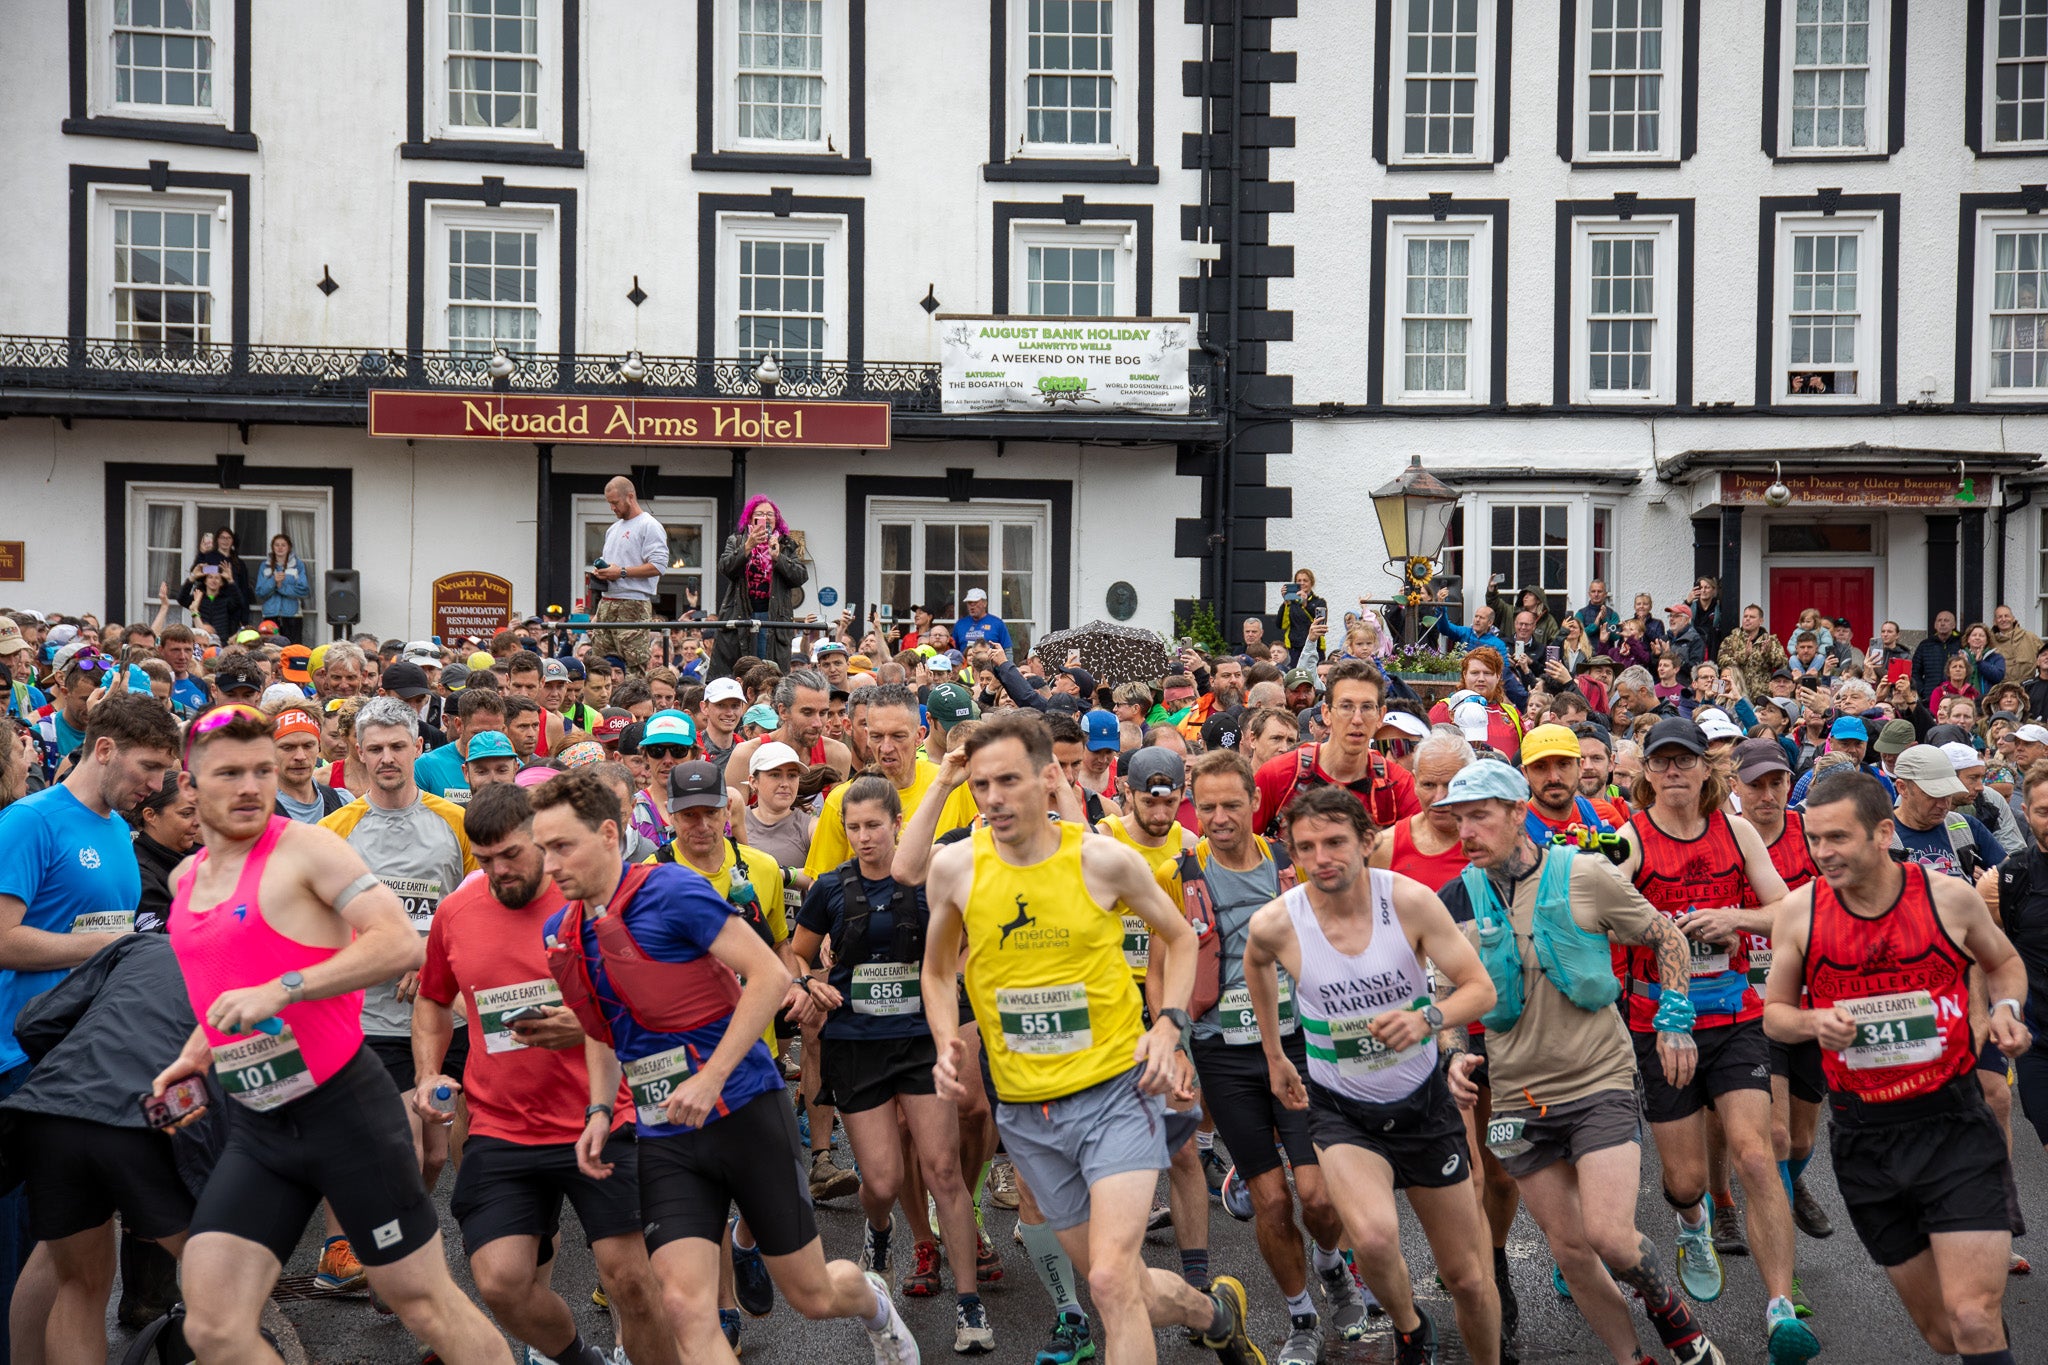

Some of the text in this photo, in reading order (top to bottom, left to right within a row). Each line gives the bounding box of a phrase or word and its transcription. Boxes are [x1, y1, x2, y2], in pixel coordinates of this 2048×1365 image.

[980, 327, 1151, 341] AUGUST BANK HOLIDAY
[1019, 341, 1112, 351] LLANWRTYD WELLS
[991, 354, 1141, 365] A WEEKEND ON THE BOG
[968, 380, 1024, 389] BOGATHLON
[1038, 376, 1088, 392] GREEN
[1130, 383, 1185, 391] BOGSNORKELLING
[605, 405, 698, 436] Arms
[712, 406, 803, 438] Hotel
[1736, 475, 1768, 488] Home
[1787, 479, 1806, 488] the
[1811, 475, 1844, 489] Heart
[1848, 480, 1860, 490] of
[1864, 478, 1900, 489] Wales
[1904, 478, 1952, 491] Brewery
[1803, 491, 1844, 502] Brewed
[1865, 494, 1884, 502] the
[1888, 492, 1940, 502] Premises
[480, 578, 507, 595] Arms
[460, 590, 487, 600] Hotel
[439, 606, 506, 615] ACCOMMODATION
[447, 617, 499, 625] RESTAURANT
[449, 627, 495, 636] BAR SNACKS
[1380, 895, 1391, 925] soar
[85, 915, 112, 926] WHOLE
[1014, 926, 1069, 940] mercia
[863, 967, 887, 977] WHOLE
[870, 982, 903, 999] 656
[1319, 969, 1406, 999] SWANSEA
[489, 990, 519, 1004] WHOLE
[1008, 993, 1040, 1005] WHOLE
[1323, 981, 1413, 1015] HARRIERS
[1849, 1001, 1886, 1016] WHOLE
[1021, 1012, 1062, 1034] 551
[1049, 1031, 1074, 1040] JONES
[1863, 1021, 1908, 1044] 341
[222, 1043, 248, 1062] WHOLE
[1855, 1040, 1927, 1055] ANTHONY GLOVER
[236, 1061, 278, 1091] 101
[641, 1078, 671, 1103] 752
[1490, 1123, 1514, 1143] 699
